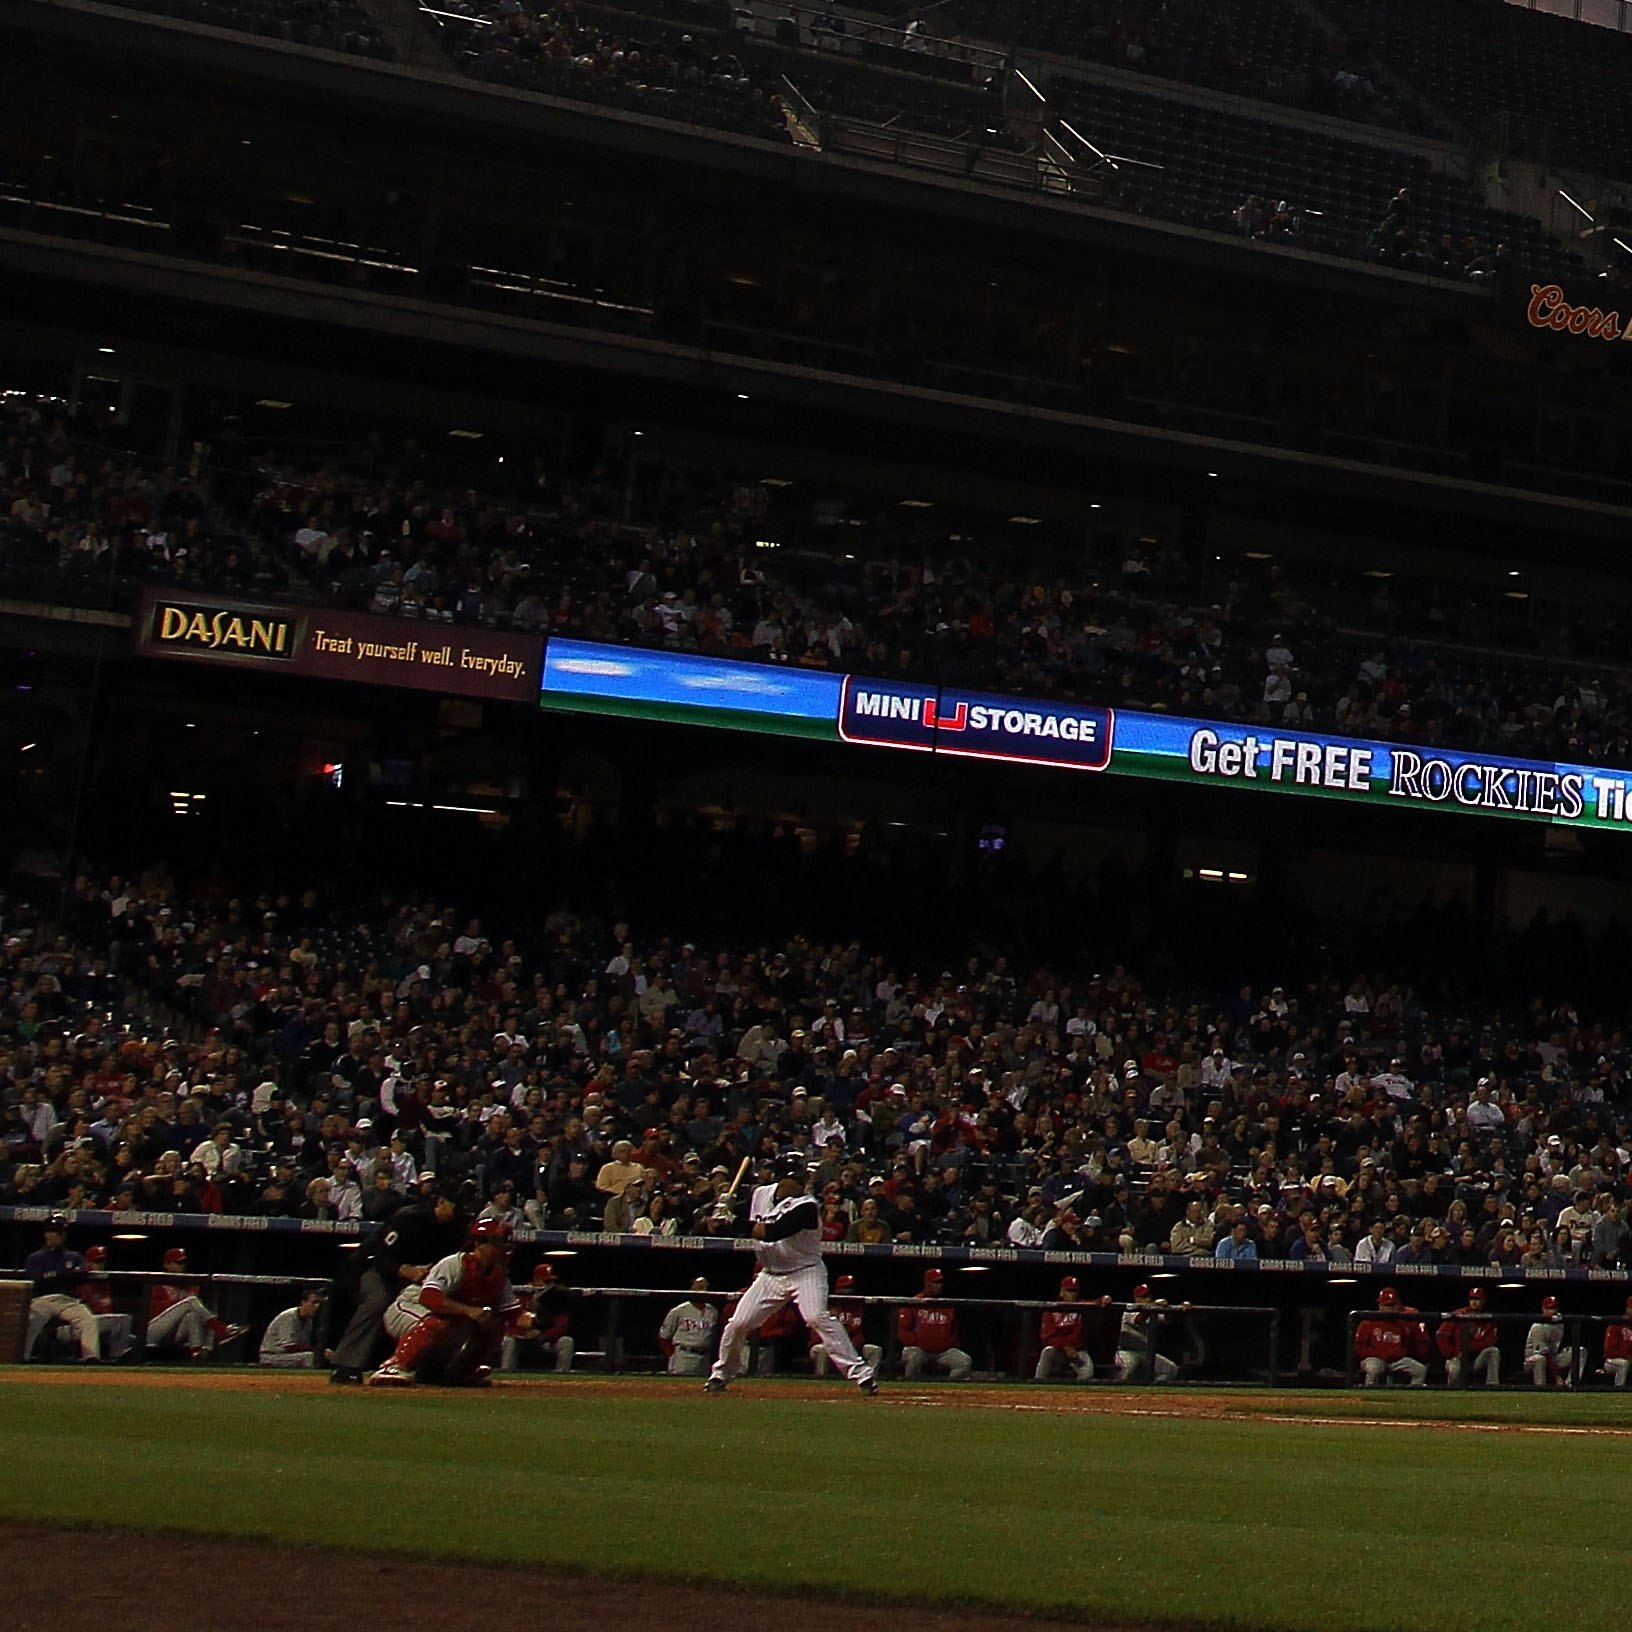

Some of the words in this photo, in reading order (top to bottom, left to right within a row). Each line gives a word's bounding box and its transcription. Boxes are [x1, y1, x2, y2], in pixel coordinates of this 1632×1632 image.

[1527, 284, 1621, 341] Coors
[161, 607, 287, 652] DASANI
[314, 630, 353, 654] Treat
[357, 641, 418, 660] yourself
[421, 646, 454, 667] well.
[460, 649, 526, 677] Everyday.
[855, 691, 920, 721] MINI
[969, 706, 1096, 742] STORAGE
[1191, 730, 1258, 777] Get
[1271, 740, 1373, 791] FREE
[1391, 750, 1583, 818] ROCKIES
